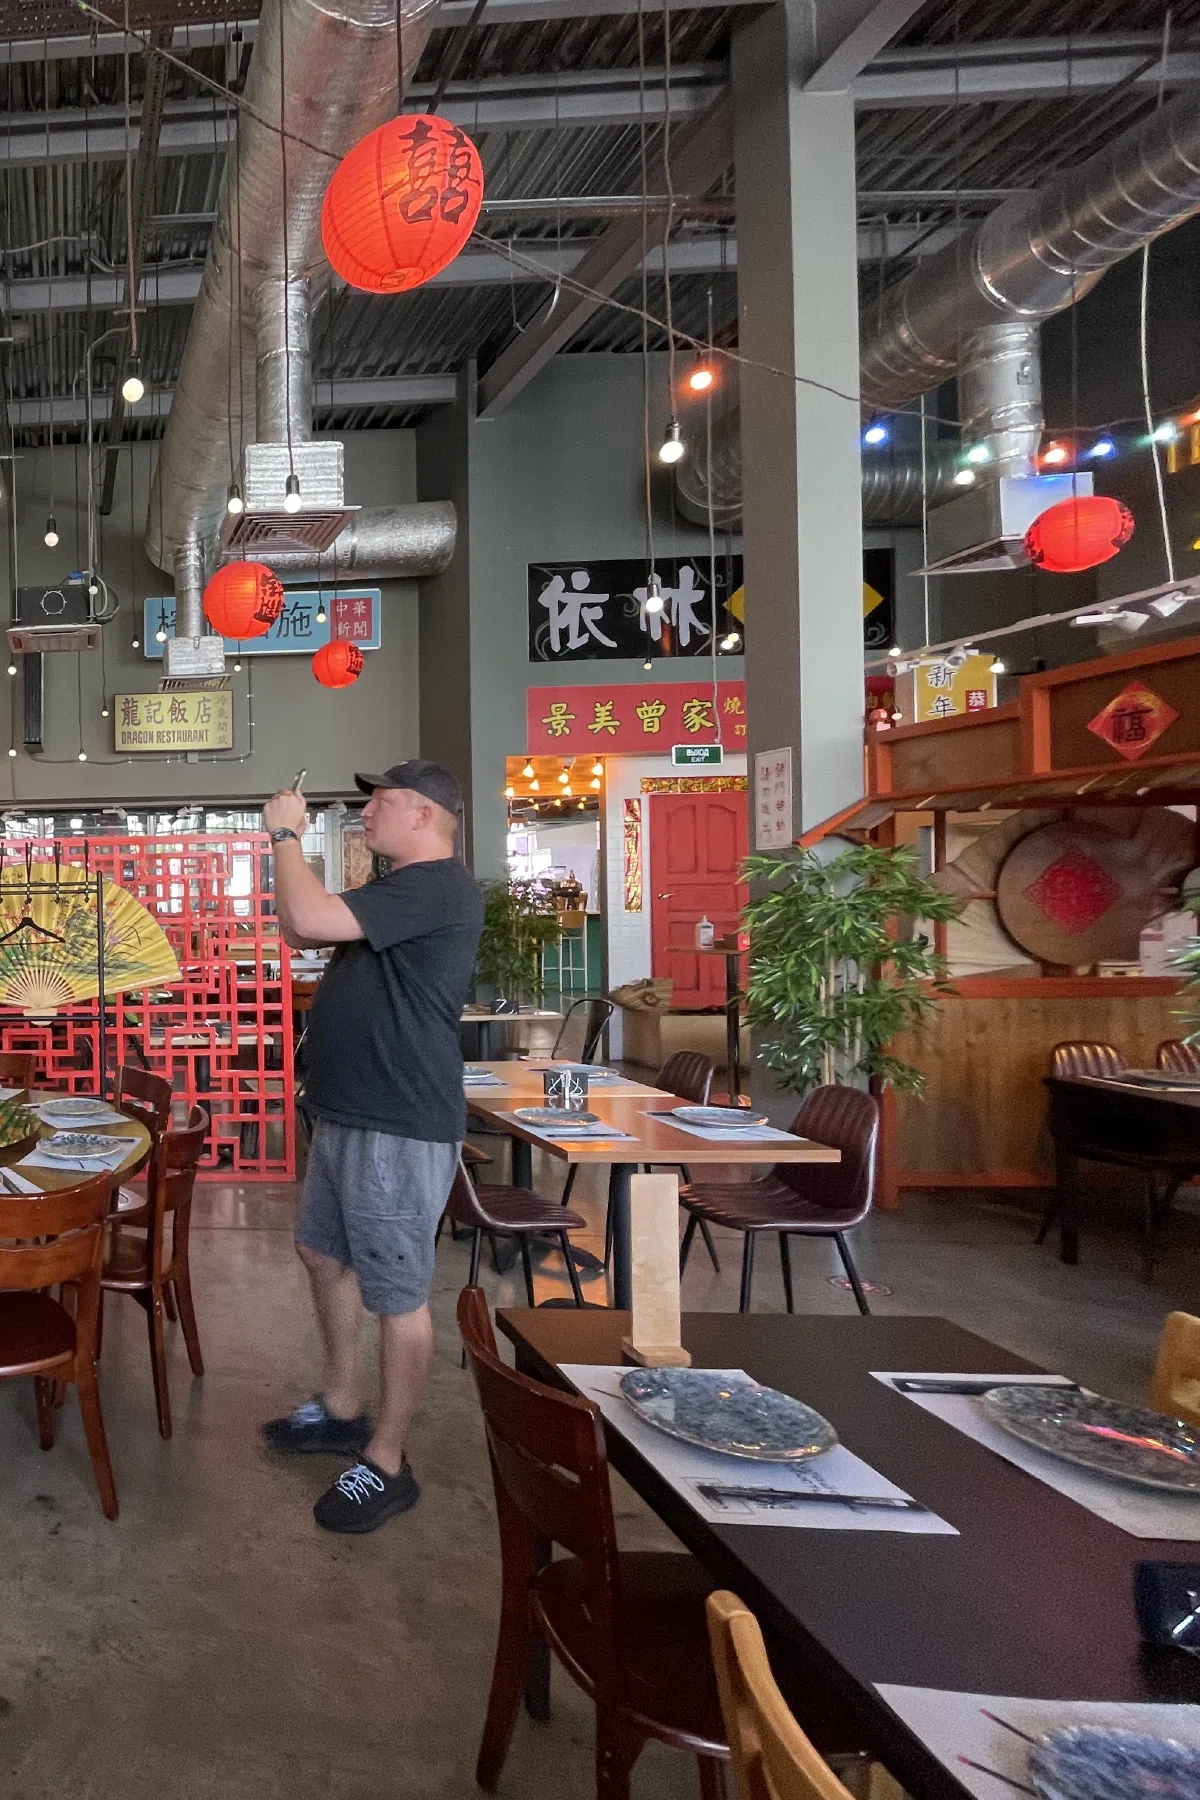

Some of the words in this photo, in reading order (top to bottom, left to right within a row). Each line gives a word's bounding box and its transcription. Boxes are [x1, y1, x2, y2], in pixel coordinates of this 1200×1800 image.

[336, 600, 367, 618] 中華
[538, 564, 710, 652] 依林
[926, 663, 957, 718] 新年
[121, 696, 212, 727] 龍記飯店
[541, 697, 717, 737] 景美曾家
[121, 730, 154, 744] DRAGON
[156, 729, 210, 744] RESTAURANT
[686, 748, 710, 757] ВЫХОД
